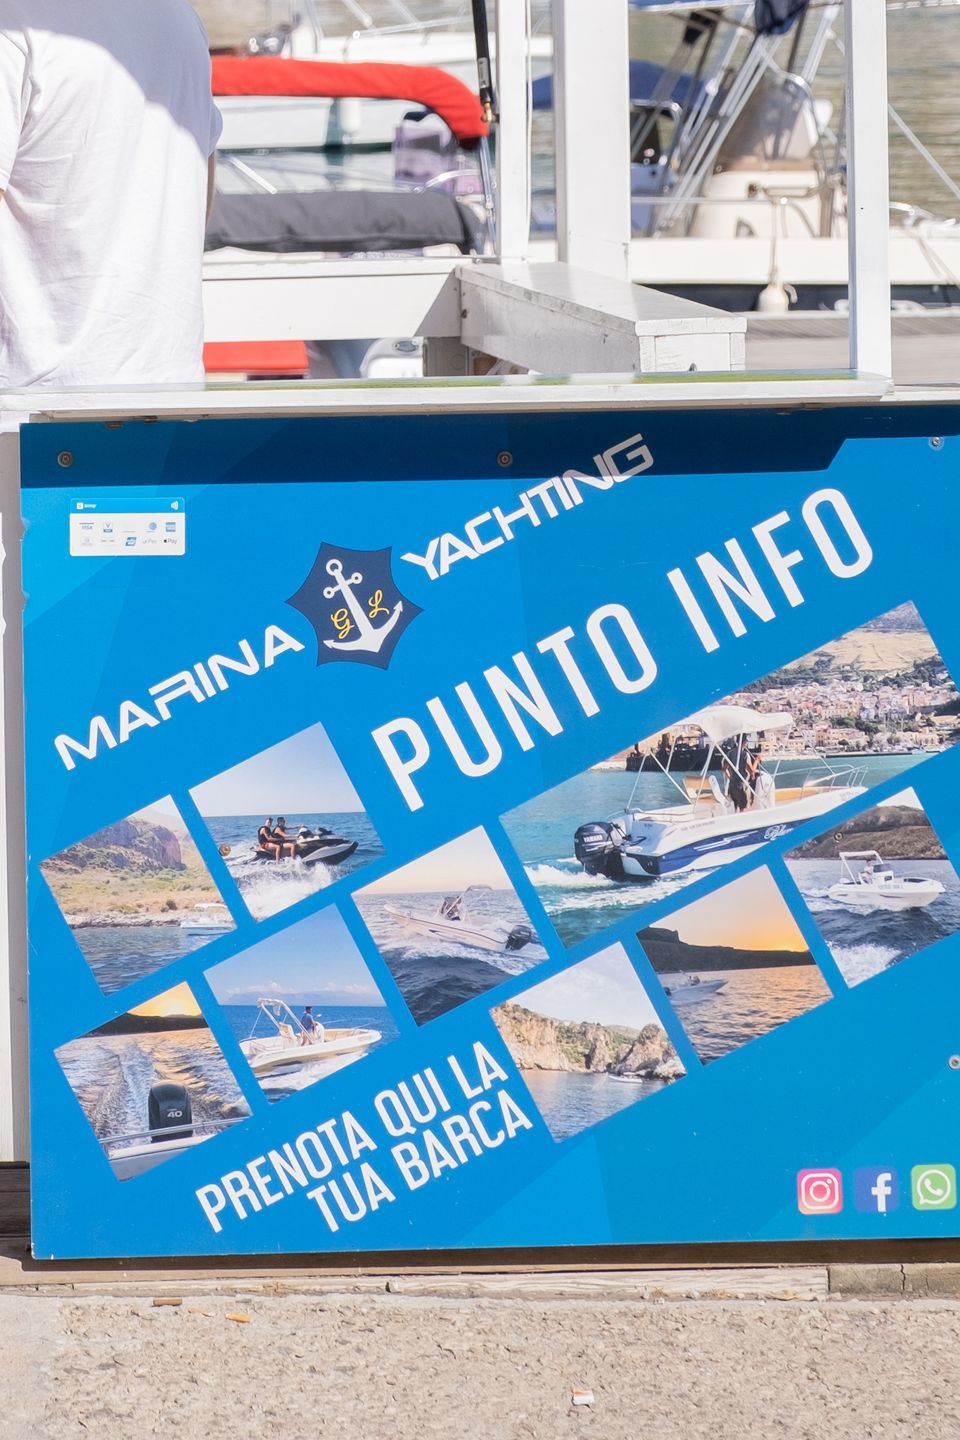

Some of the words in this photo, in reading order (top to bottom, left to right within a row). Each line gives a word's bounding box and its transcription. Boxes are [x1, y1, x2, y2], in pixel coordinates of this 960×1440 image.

[53, 624, 306, 771] MARINA
[400, 432, 656, 582] YACHTING
[370, 602, 659, 813] PUNTO
[666, 487, 874, 656] INFO
[167, 1110, 183, 1118] 40
[194, 1110, 378, 1234] PRENOTA
[373, 1066, 452, 1138] QUI
[447, 1040, 509, 1100] LA
[305, 1162, 397, 1233] TUA
[390, 1089, 534, 1192] BARCA
